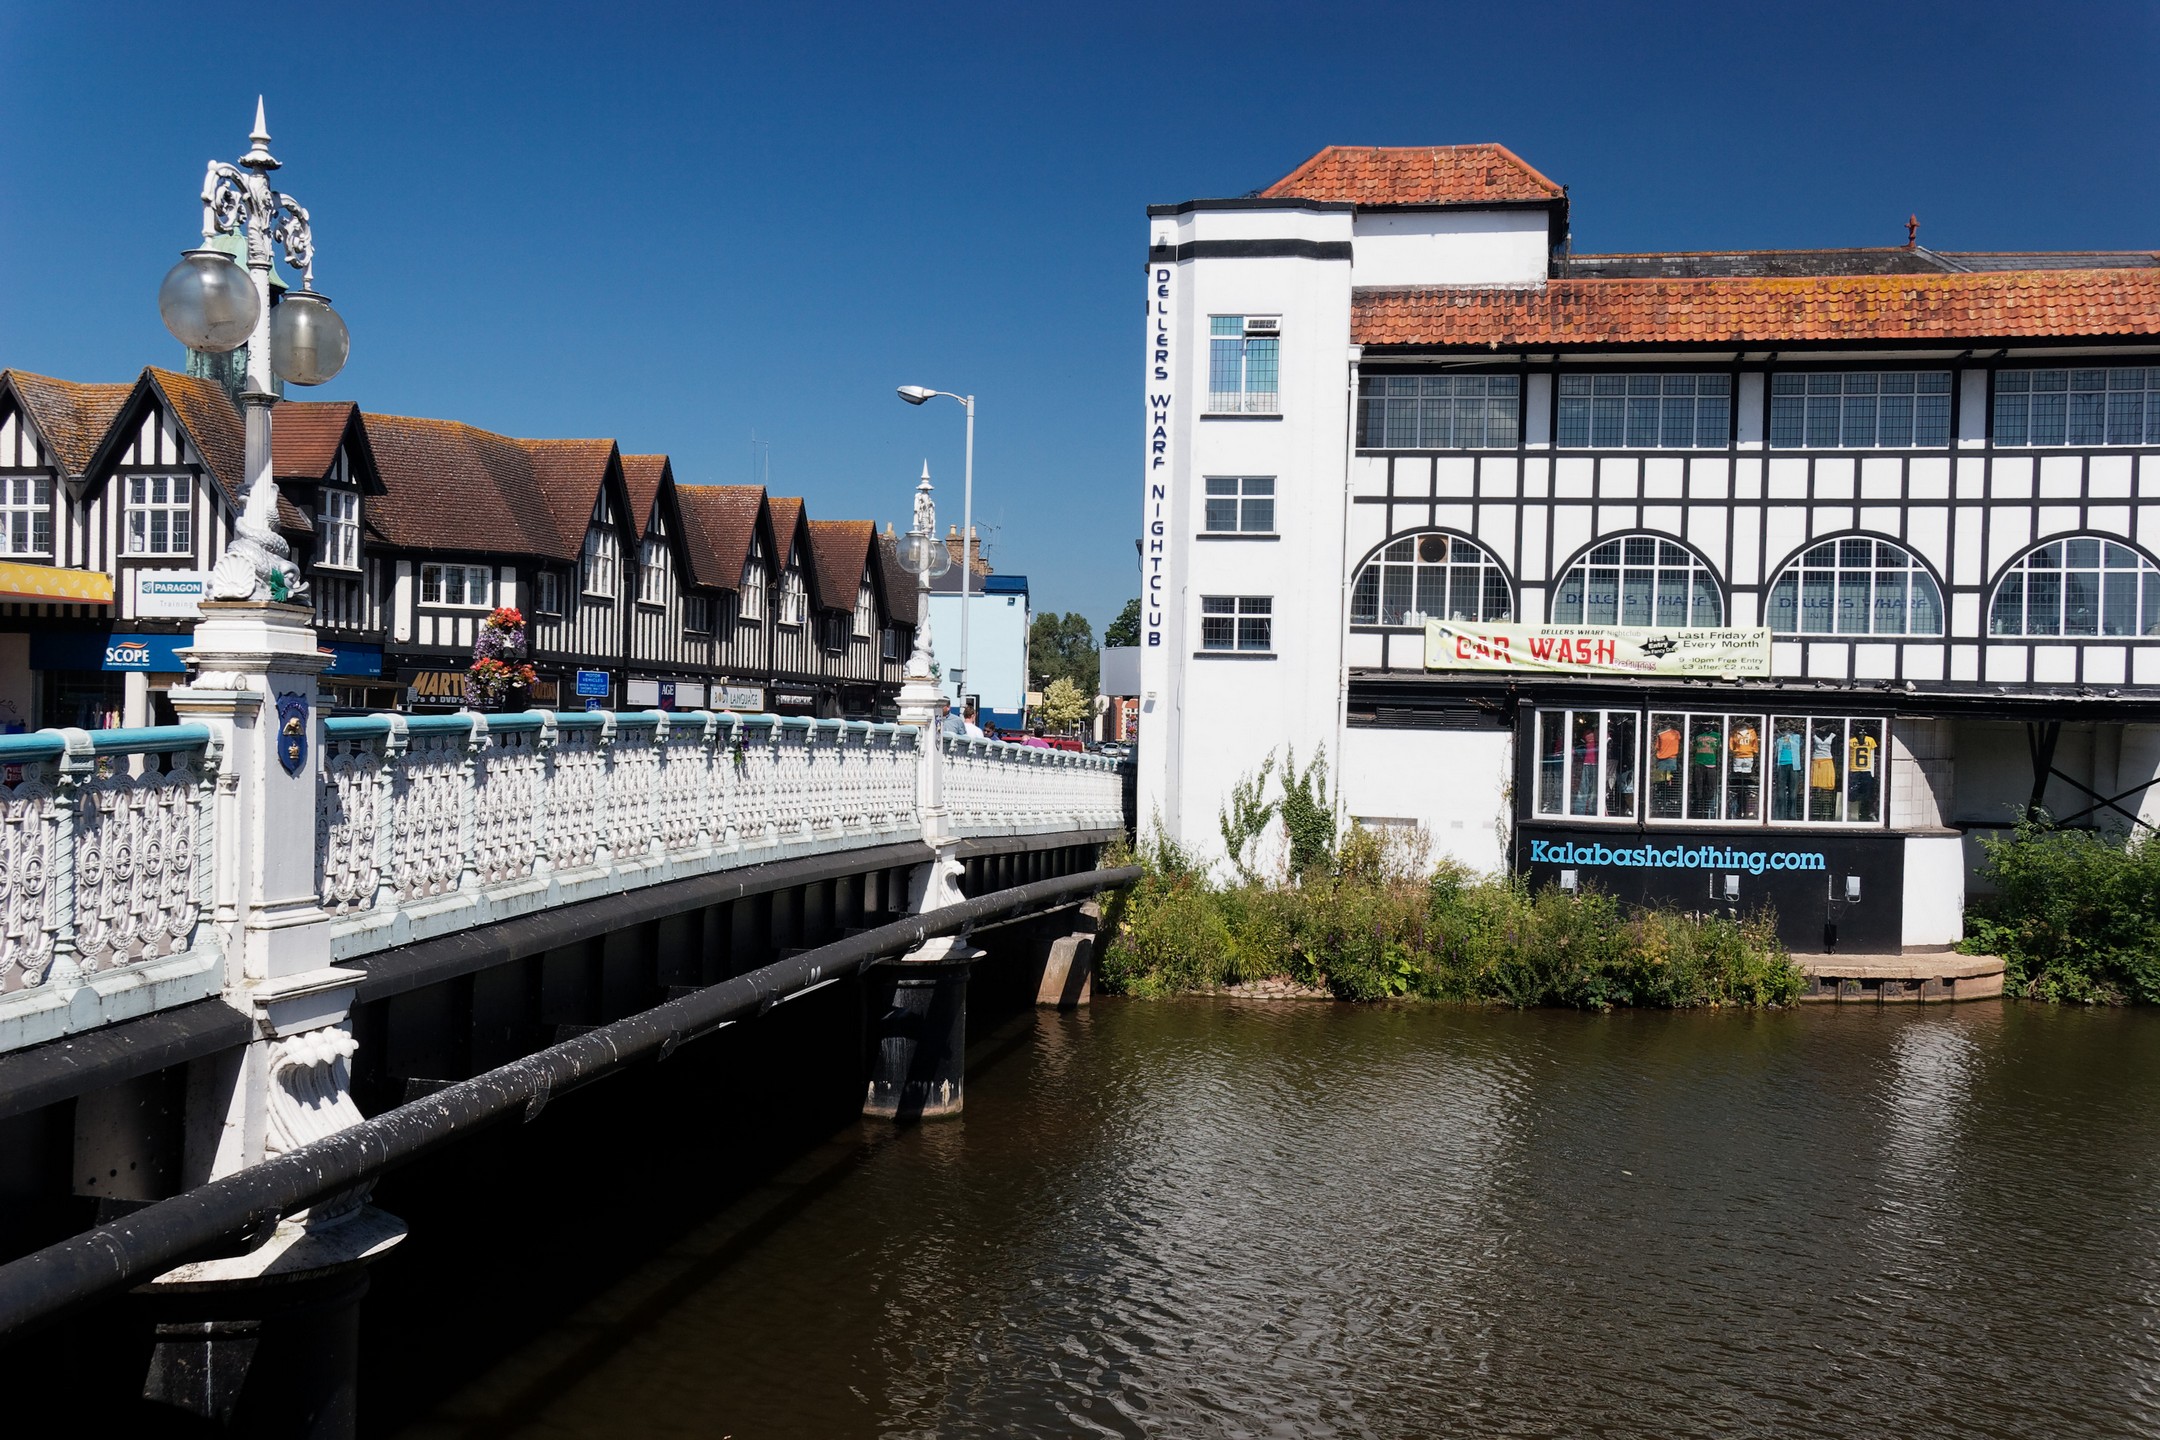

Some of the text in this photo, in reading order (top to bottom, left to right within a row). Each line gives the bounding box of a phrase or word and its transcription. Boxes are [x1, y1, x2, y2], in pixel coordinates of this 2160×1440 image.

[1148, 269, 1171, 647] DELLERS WHARF NIGHTCLUB
[154, 583, 201, 592] PARAGON
[160, 600, 194, 608] Training
[1607, 630, 1641, 639] Nightclub
[1677, 631, 1765, 641] Last Friday of
[1456, 635, 1616, 665] CAR WASH
[1648, 642, 1669, 650] Entry
[1683, 640, 1760, 650] Every Month
[106, 648, 150, 663] SCOPE
[662, 685, 674, 695] AGE
[730, 693, 758, 706] LANGUAGE
[1855, 747, 1869, 768] 6
[1531, 840, 1826, 875] Kalabashclothing.com
